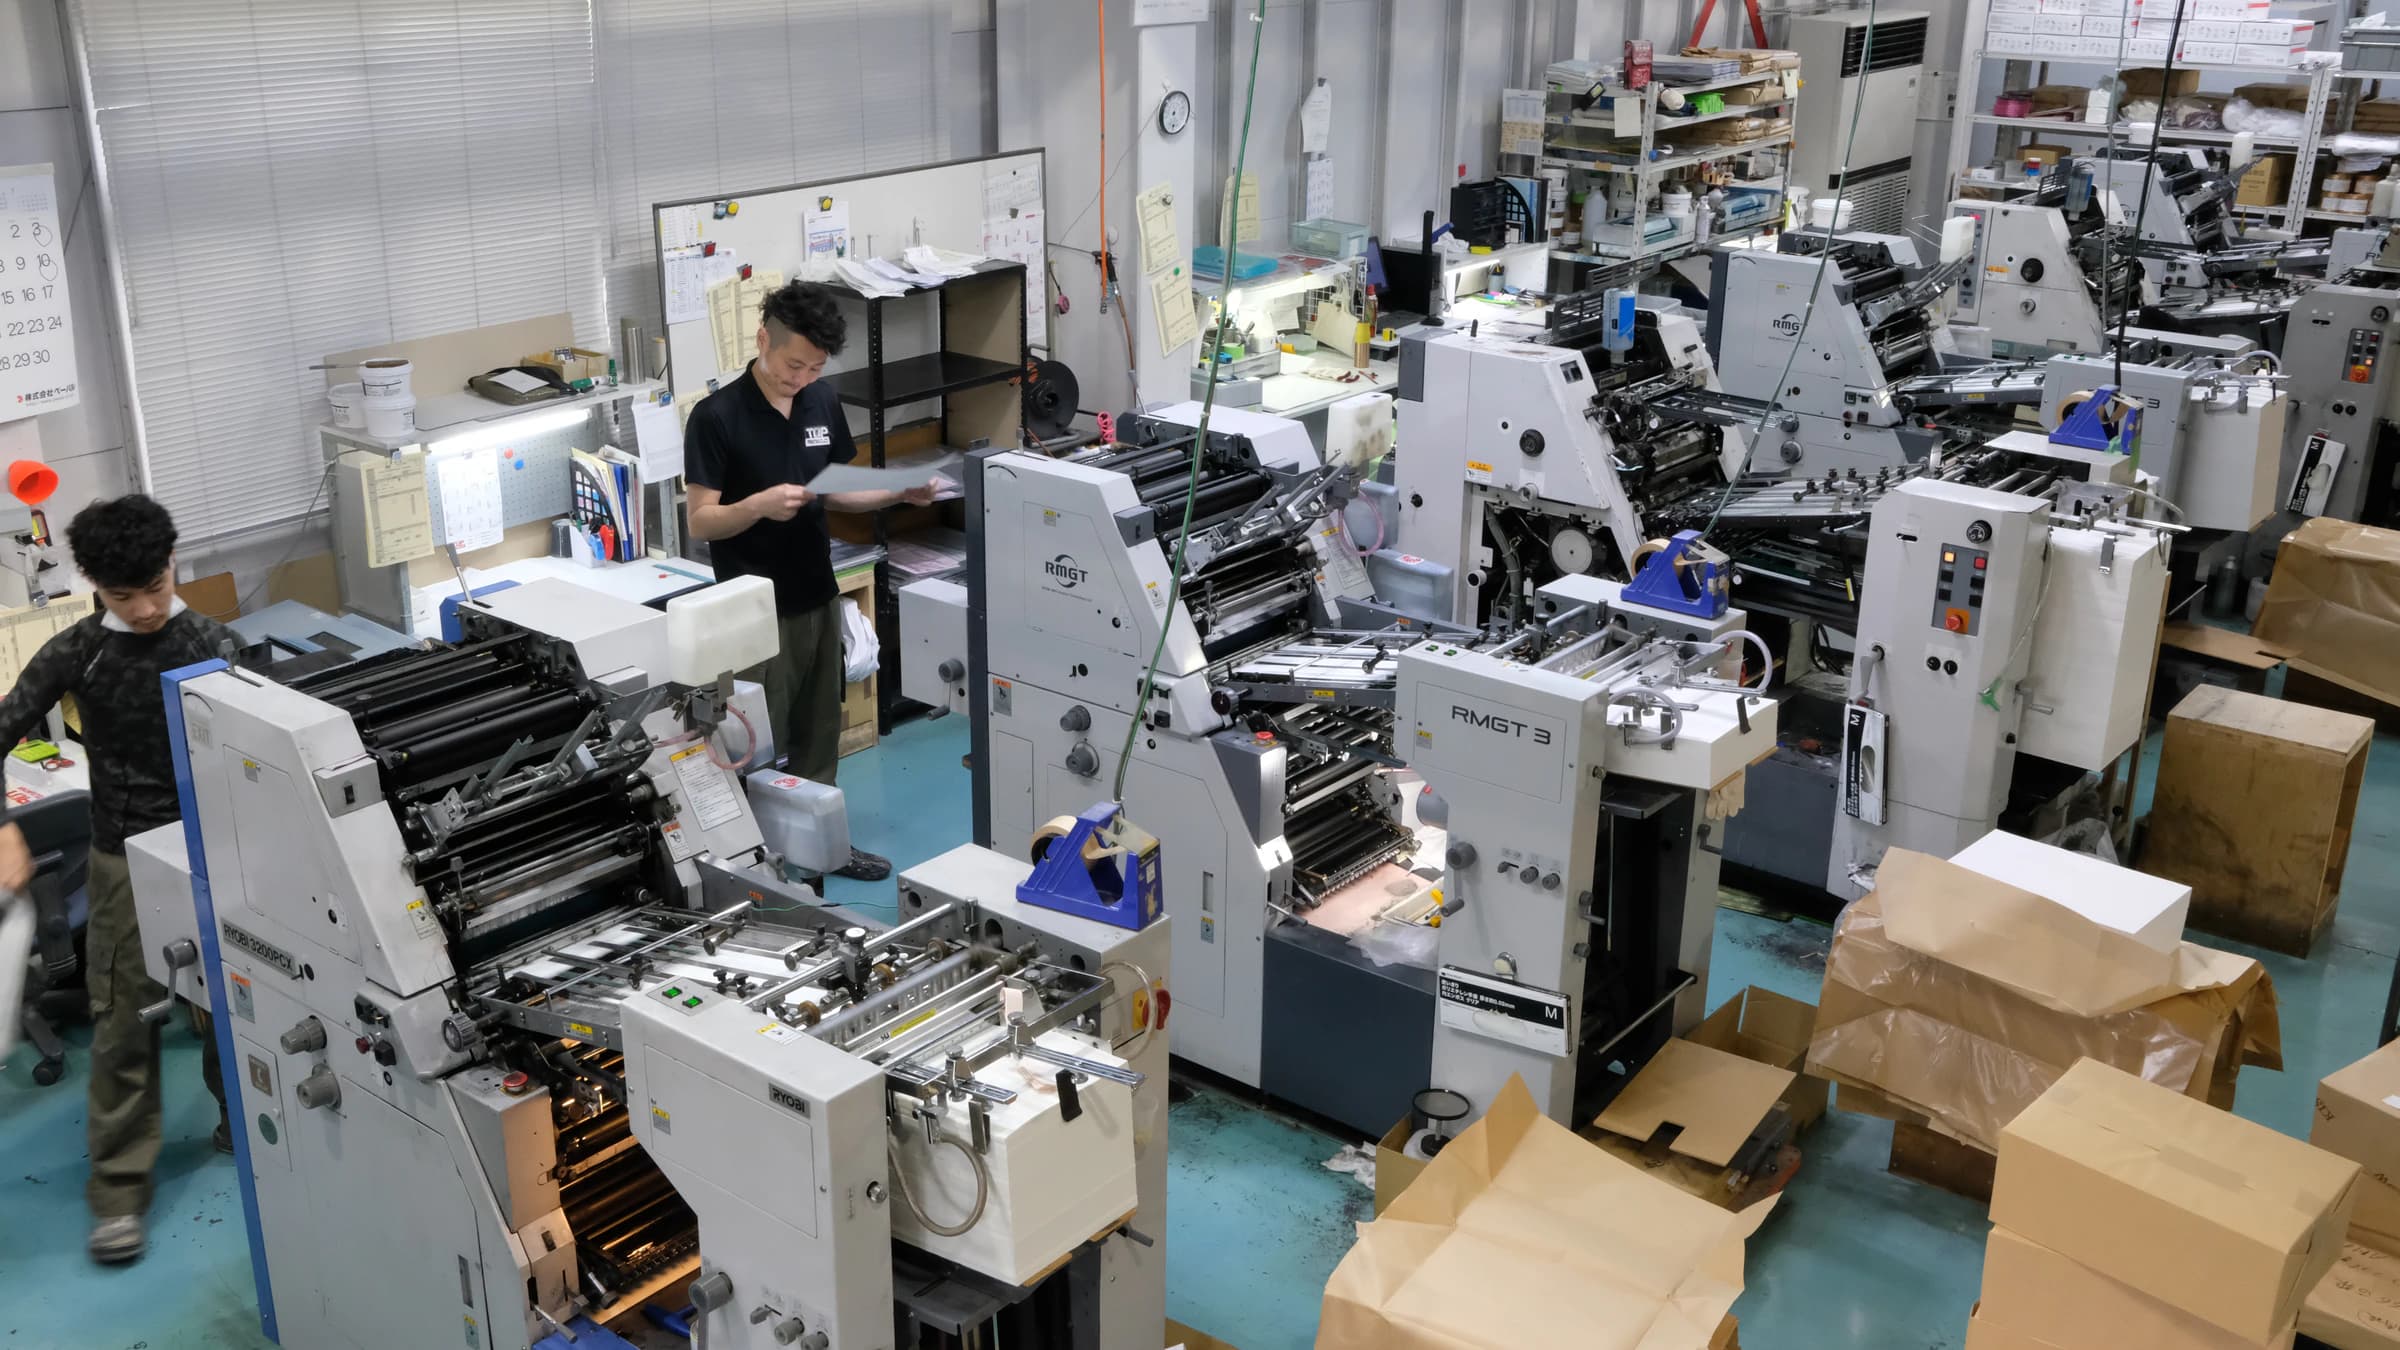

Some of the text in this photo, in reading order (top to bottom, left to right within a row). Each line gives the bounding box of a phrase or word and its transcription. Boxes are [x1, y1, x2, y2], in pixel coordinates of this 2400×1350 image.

[10, 222, 41, 238] 2 3
[15, 256, 26, 270] 9
[37, 253, 51, 267] 10
[1, 285, 54, 304] 15 16 17
[7, 315, 62, 337] 22 23 24
[0, 349, 51, 371] 8 29 30
[1045, 561, 1089, 584] RMGT
[1452, 705, 1551, 745] RMGT 3
[1849, 713, 1861, 726] M
[223, 923, 293, 971] RYOBI 3200PCX
[1545, 1005, 1558, 1020] M
[772, 1087, 805, 1113] RYOBI
